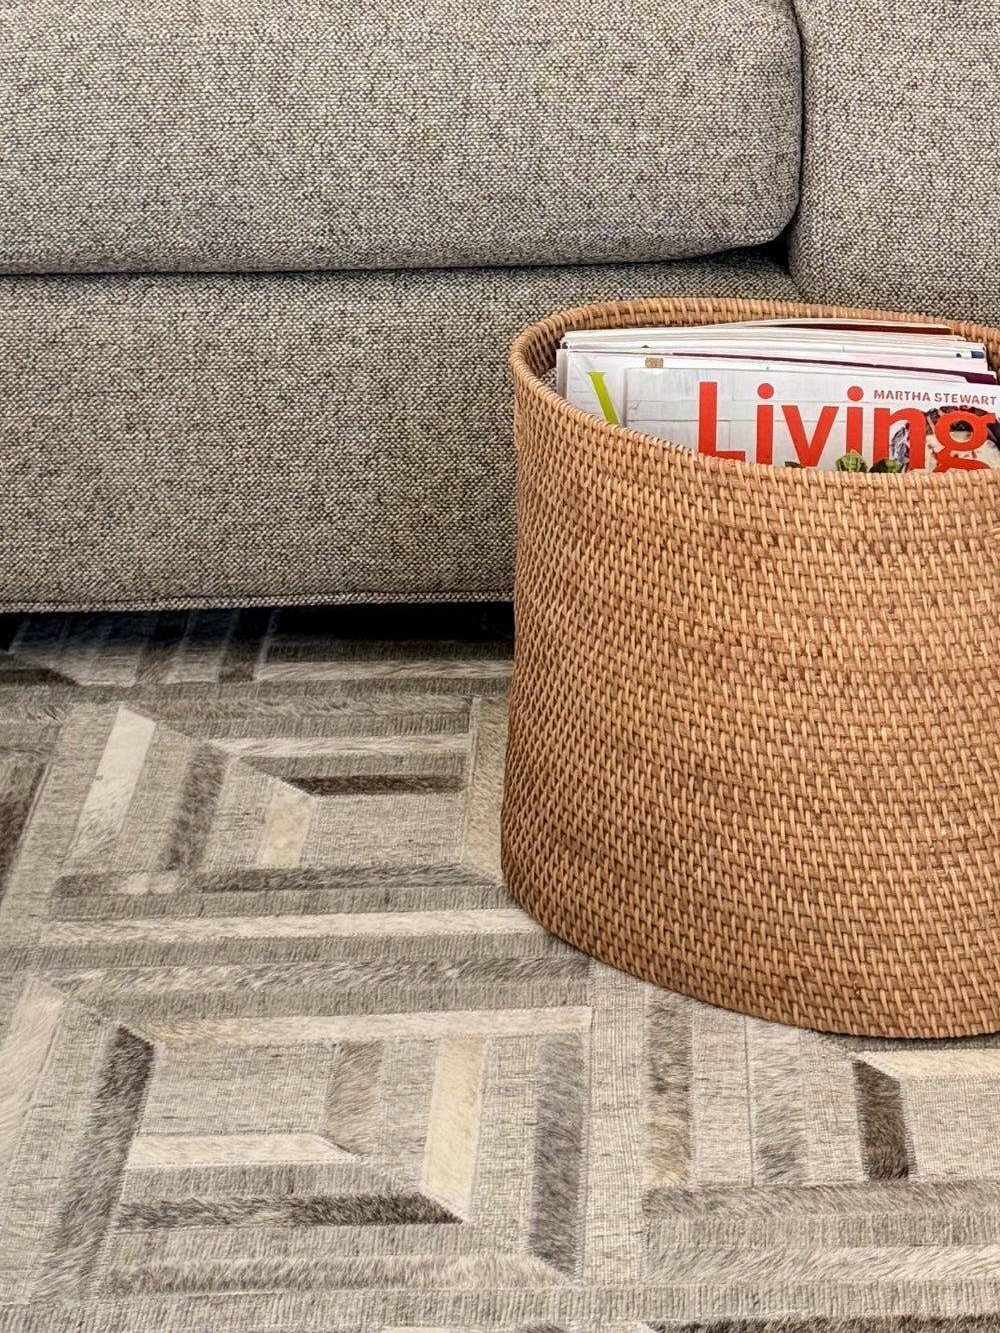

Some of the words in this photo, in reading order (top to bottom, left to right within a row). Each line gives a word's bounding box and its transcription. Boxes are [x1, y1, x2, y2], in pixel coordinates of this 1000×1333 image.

[873, 389, 931, 403] MARTHA
[934, 393, 998, 406] STEWART
[698, 381, 996, 473] Living
